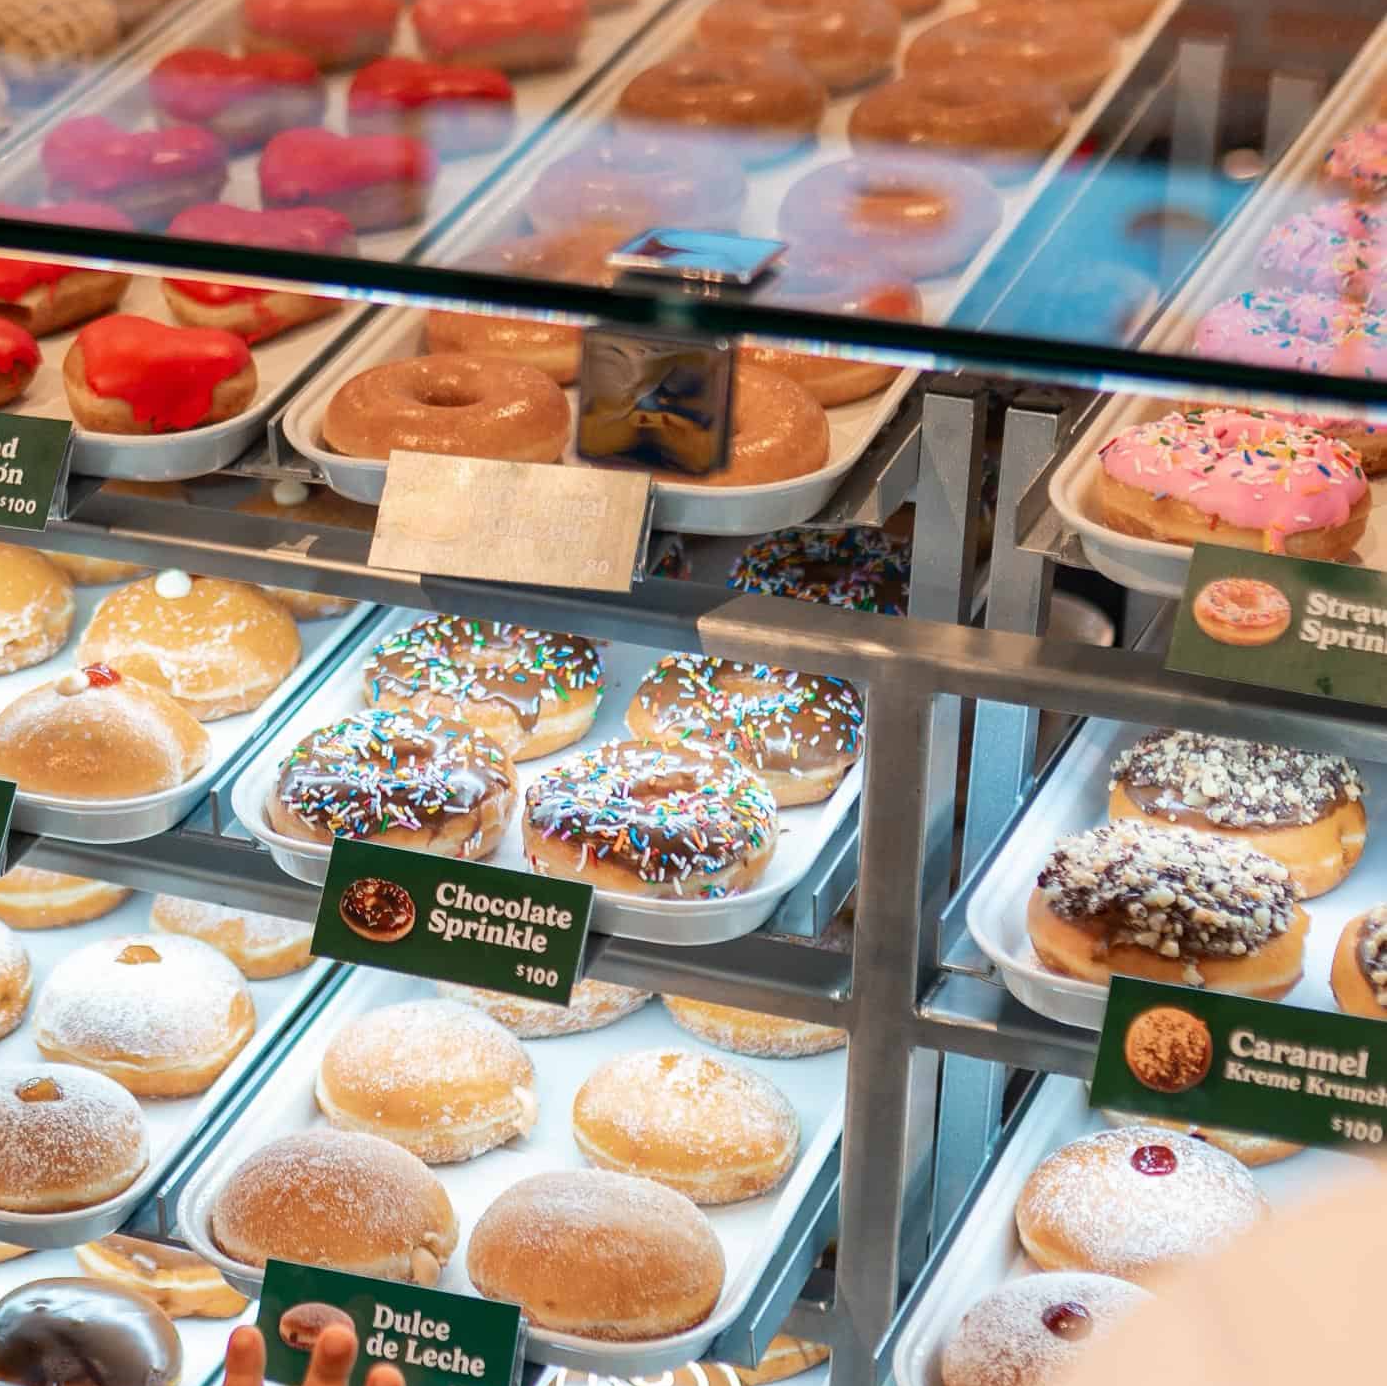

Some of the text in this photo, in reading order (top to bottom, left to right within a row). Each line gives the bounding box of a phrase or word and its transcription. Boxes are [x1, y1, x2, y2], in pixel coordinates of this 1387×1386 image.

[1299, 618, 1387, 655] Sprin
[436, 882, 573, 930] Chocolate
[428, 908, 548, 954] Sprinkle
[516, 964, 559, 988] $100
[1229, 1029, 1370, 1079] Caramel
[1224, 1060, 1302, 1092] Kreme
[1331, 1116, 1384, 1144] $100
[372, 1303, 451, 1342] Dulce
[366, 1332, 485, 1377] de Leche
